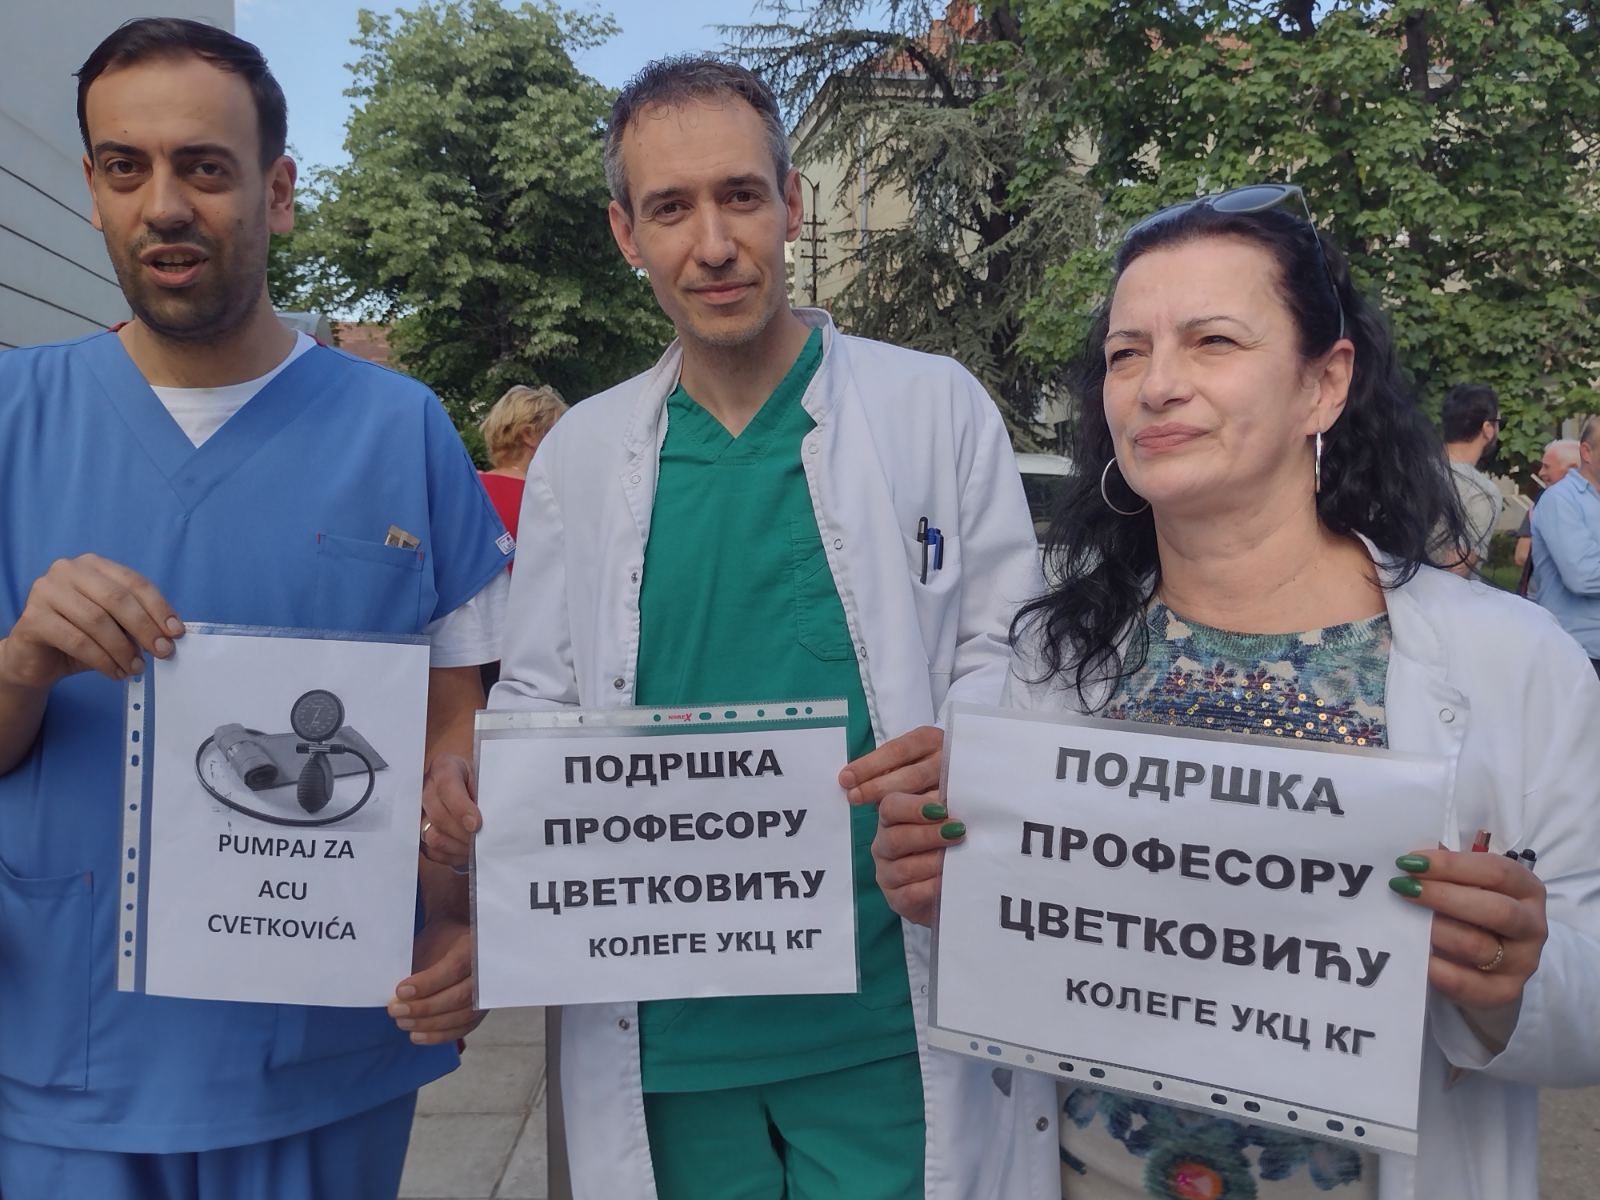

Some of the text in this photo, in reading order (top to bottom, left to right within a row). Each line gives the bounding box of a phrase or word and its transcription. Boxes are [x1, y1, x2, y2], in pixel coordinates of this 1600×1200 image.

[564, 748, 784, 788] ПОДРШКА
[1055, 746, 1345, 816] ПОДРШКА
[218, 833, 355, 859] PUMPAJ ZA
[544, 808, 808, 846] ПРОФЕСОРУ
[1020, 820, 1374, 898] ПРОФЕСОРУ
[257, 879, 308, 901] ACU
[529, 869, 826, 915] ЦВЕТКОВИЋУ
[207, 913, 357, 941] CVETKOVIĆA
[588, 928, 823, 958] КОЛЕГЕ УКЦ КГ
[1000, 895, 1391, 988] ЦВЕТКОВИЋУ
[1066, 977, 1376, 1056] КОЛЕГЕ УКЦ КГ
